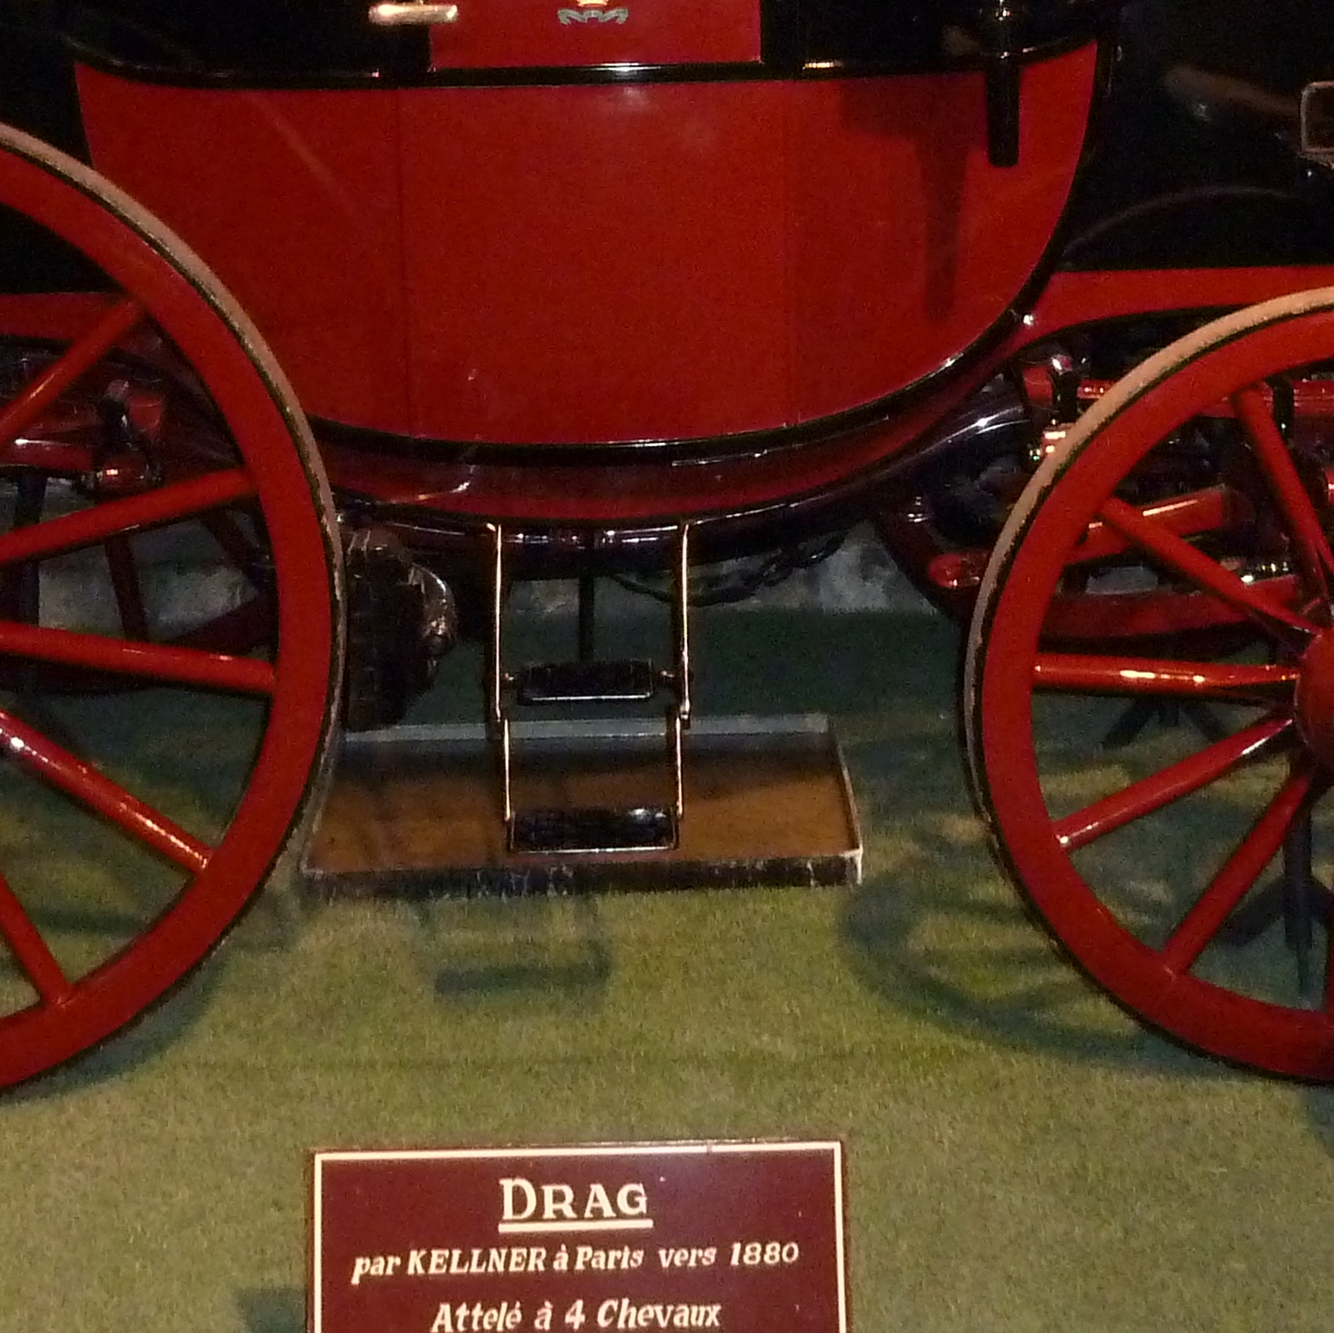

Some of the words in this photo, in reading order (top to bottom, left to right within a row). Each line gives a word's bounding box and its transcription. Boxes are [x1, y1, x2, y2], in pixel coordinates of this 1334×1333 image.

[499, 1177, 648, 1221] DRAG
[350, 1255, 402, 1285] par
[408, 1247, 546, 1275] KELLNER
[553, 1243, 569, 1271] à
[575, 1244, 644, 1270] Paris
[657, 1246, 718, 1268] vers
[730, 1241, 800, 1266] 1880
[430, 1300, 523, 1333] Attelé
[534, 1300, 554, 1331] à
[565, 1299, 586, 1330] 4
[596, 1297, 722, 1329] Chevaux
